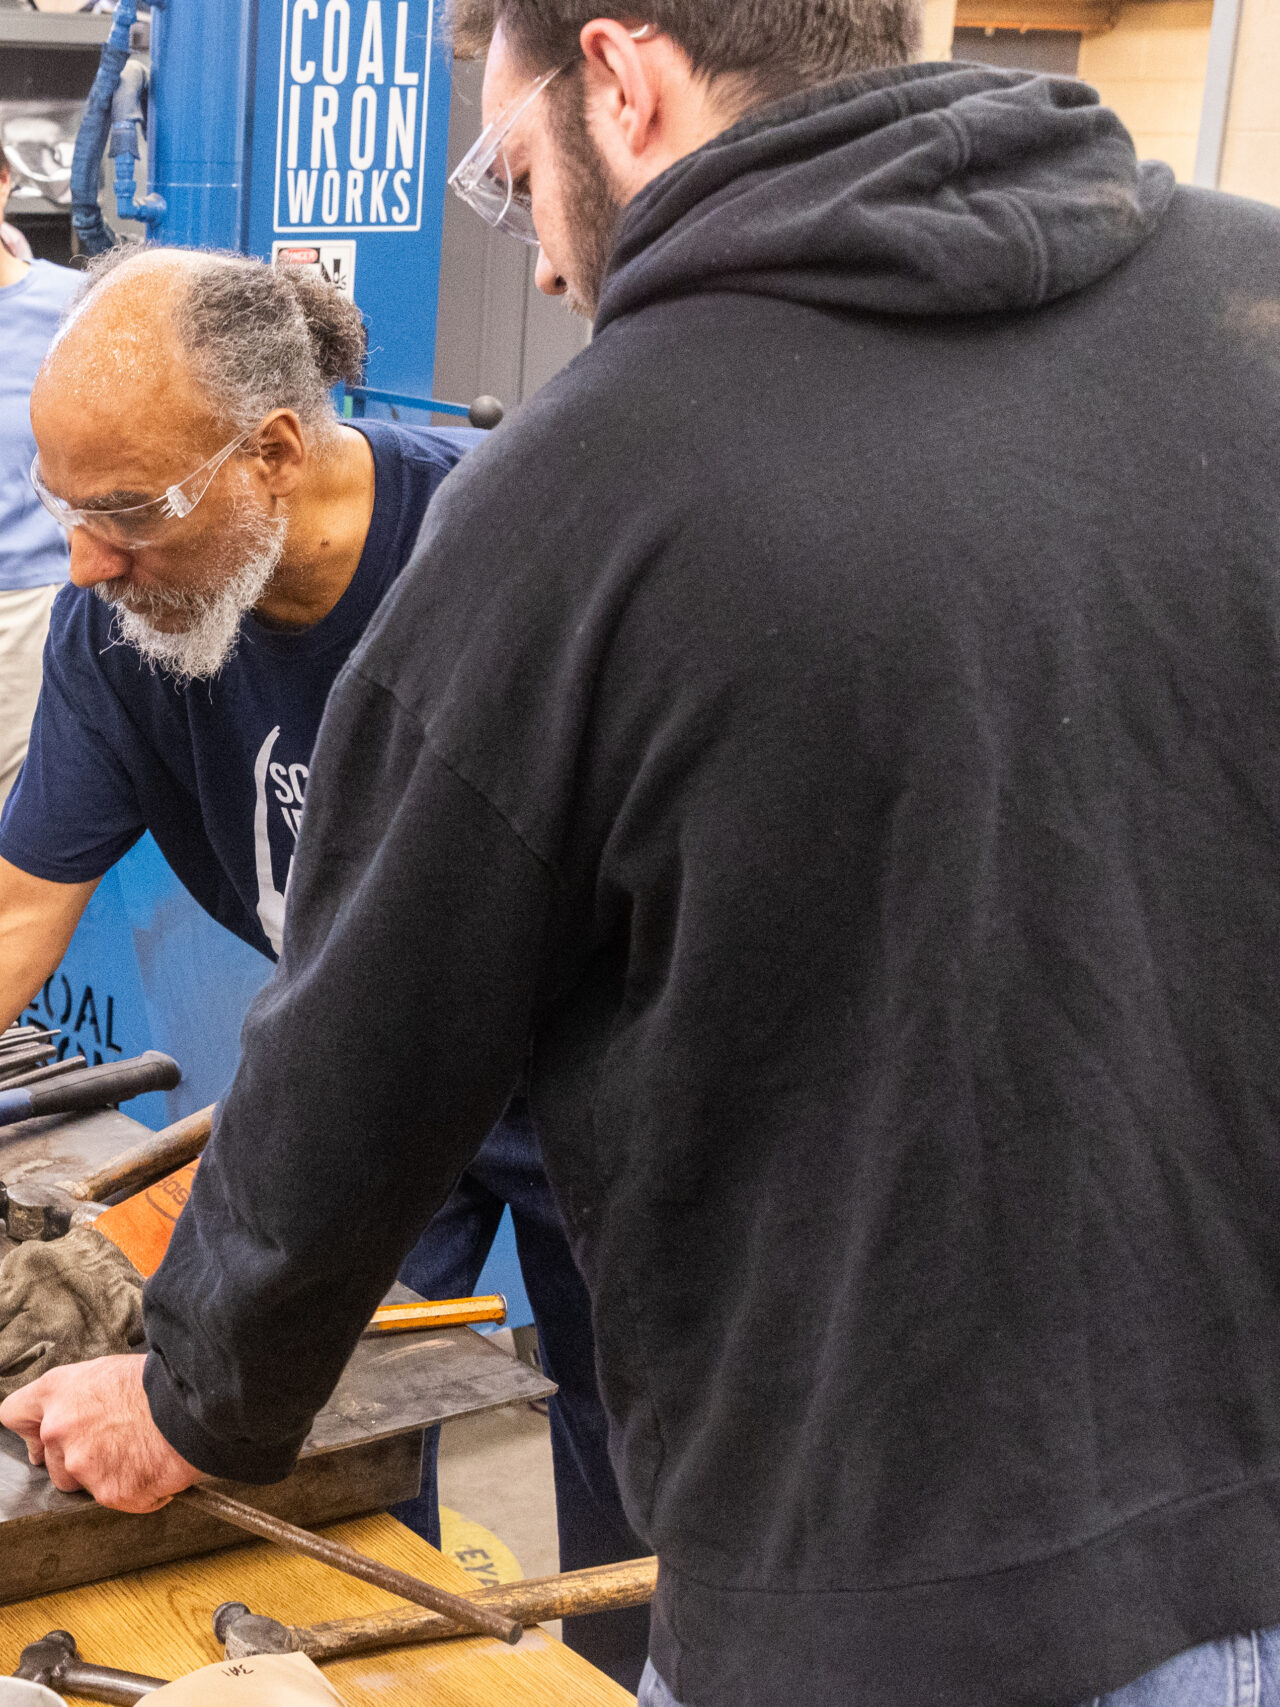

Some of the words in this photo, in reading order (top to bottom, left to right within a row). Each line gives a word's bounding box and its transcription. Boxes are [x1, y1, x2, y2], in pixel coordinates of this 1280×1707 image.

[290, 0, 420, 86] COAL
[286, 84, 418, 170] IRON
[287, 169, 412, 224] WORKS
[28, 973, 123, 1054] OAL
